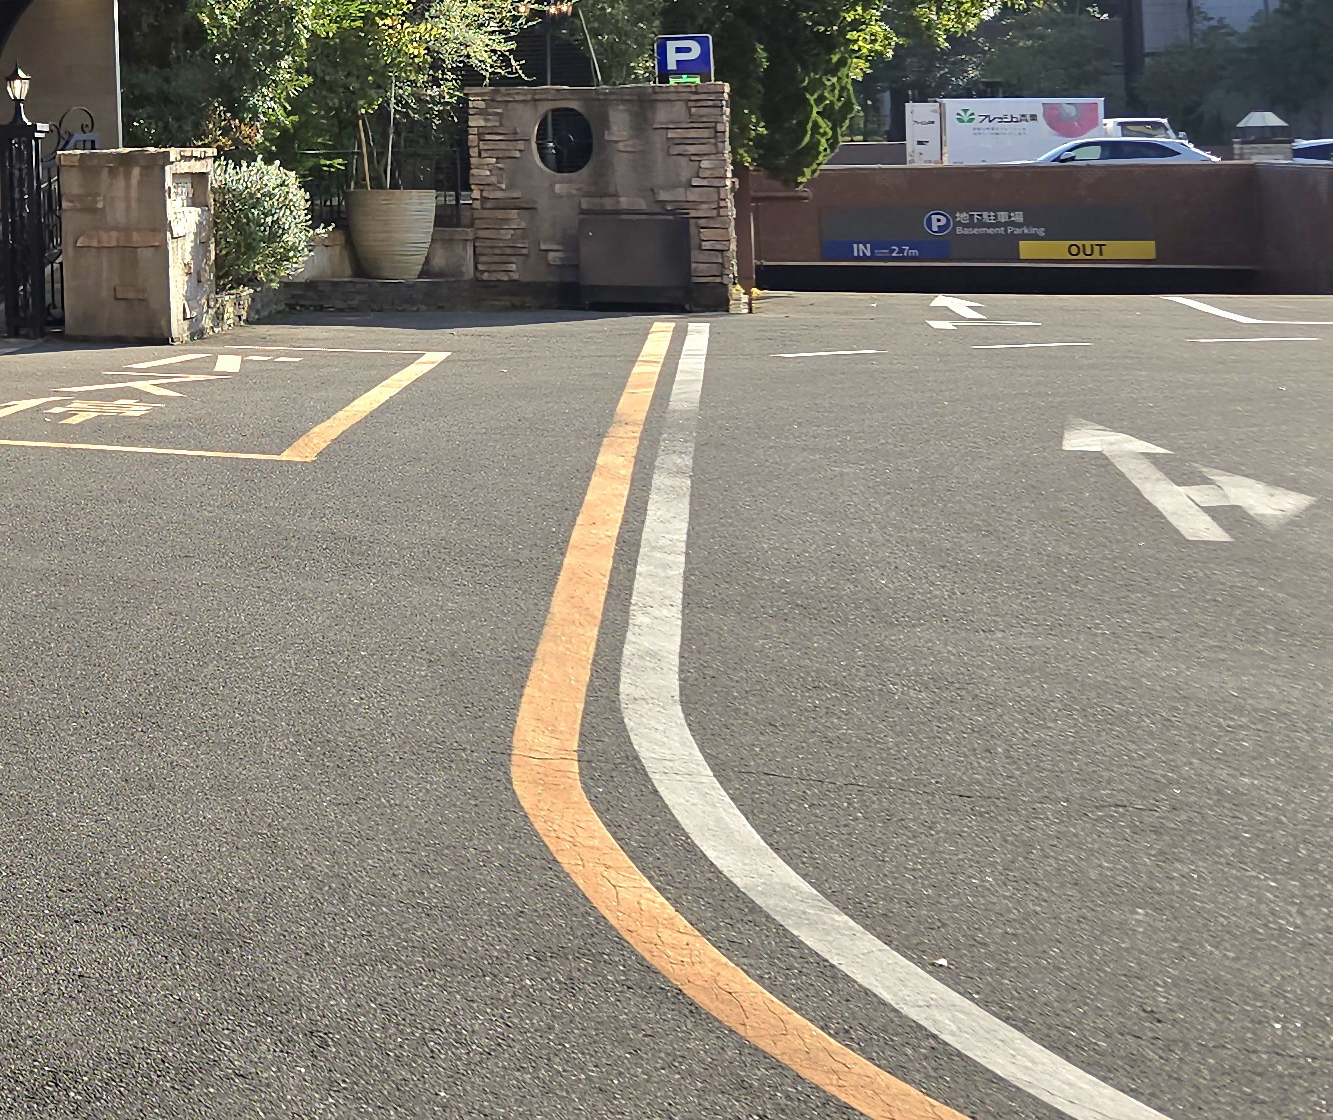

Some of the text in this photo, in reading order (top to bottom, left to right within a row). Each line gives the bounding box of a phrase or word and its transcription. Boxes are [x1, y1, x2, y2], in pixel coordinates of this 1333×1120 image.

[666, 40, 701, 70] P
[931, 215, 947, 232] P
[954, 211, 1025, 224] 地下駐車場
[955, 225, 1046, 237] Basement Parking
[852, 243, 872, 257] IN
[890, 245, 920, 257] 2.7m
[1067, 243, 1108, 257] OUT
